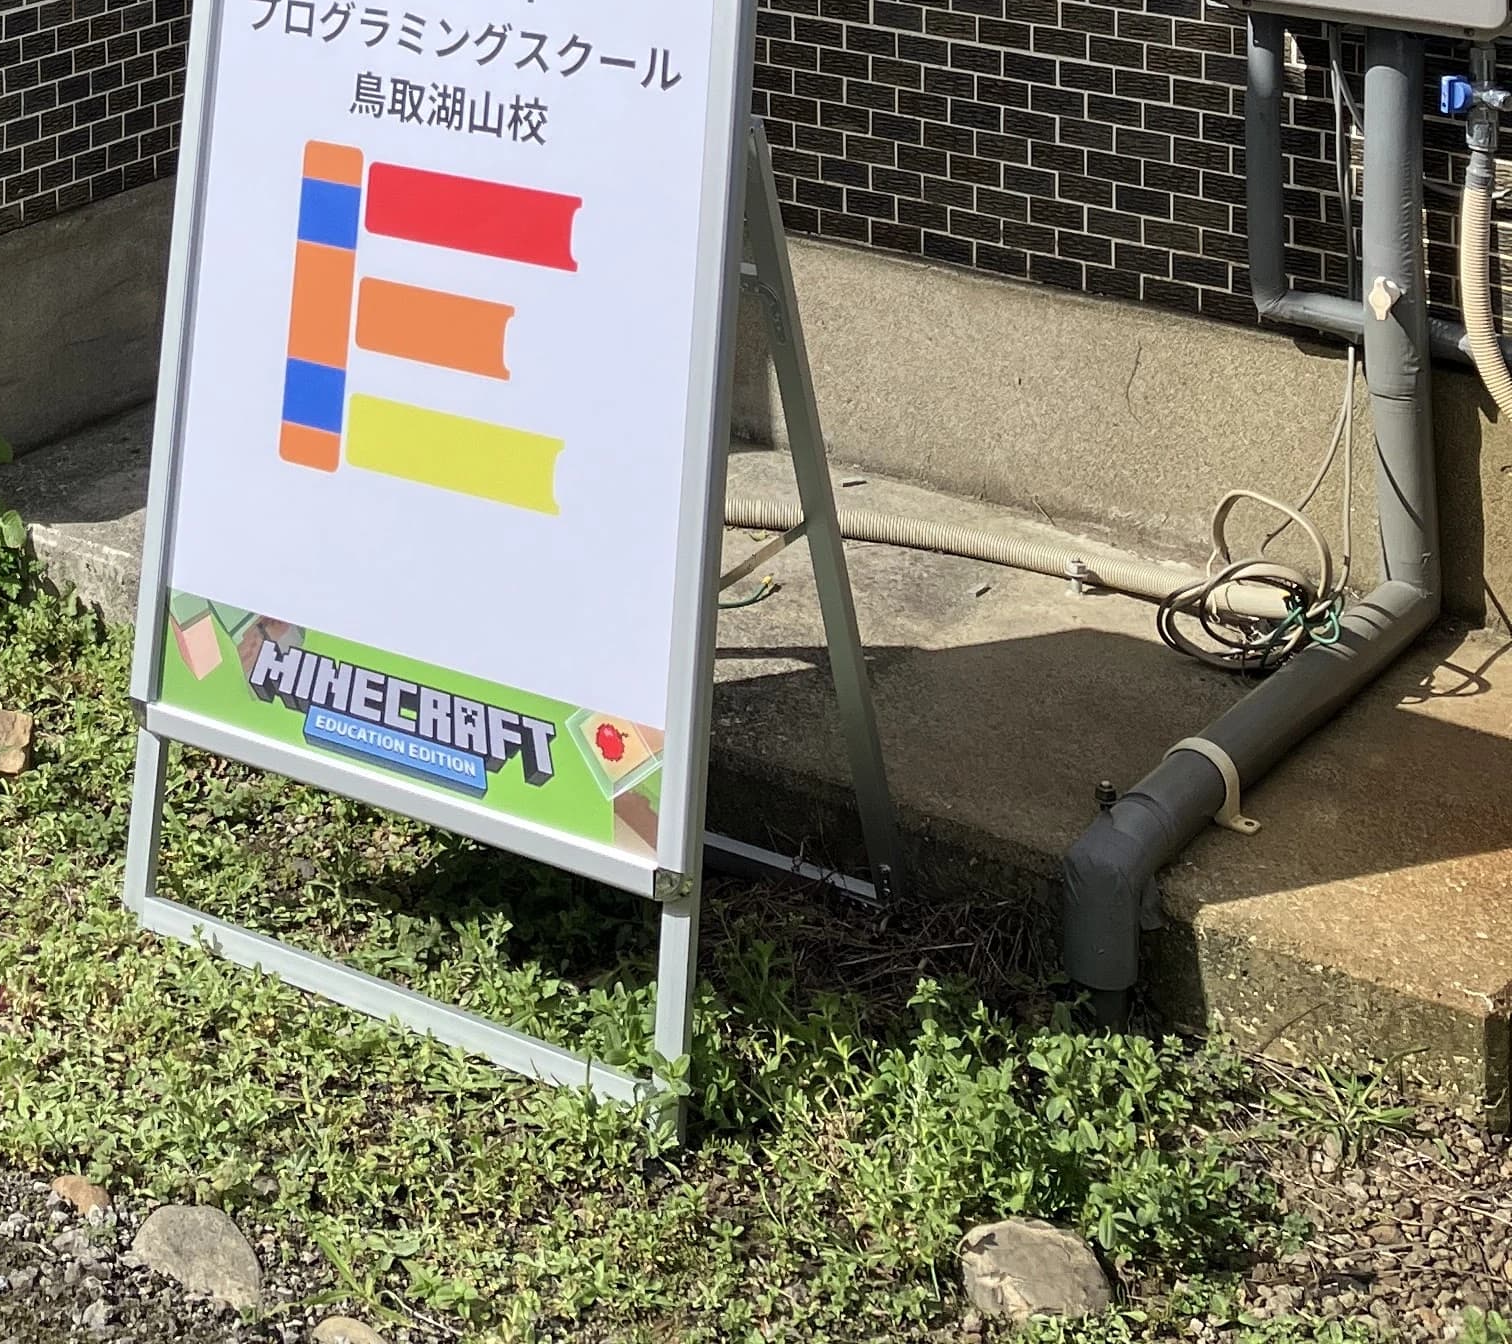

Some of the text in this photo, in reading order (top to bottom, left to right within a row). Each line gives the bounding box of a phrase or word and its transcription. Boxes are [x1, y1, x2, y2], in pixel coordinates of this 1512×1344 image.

[349, 70, 550, 146] 鳥取湖山校
[249, 640, 556, 786] MINECRAFT
[315, 715, 477, 778] EDUCATION EDITION
